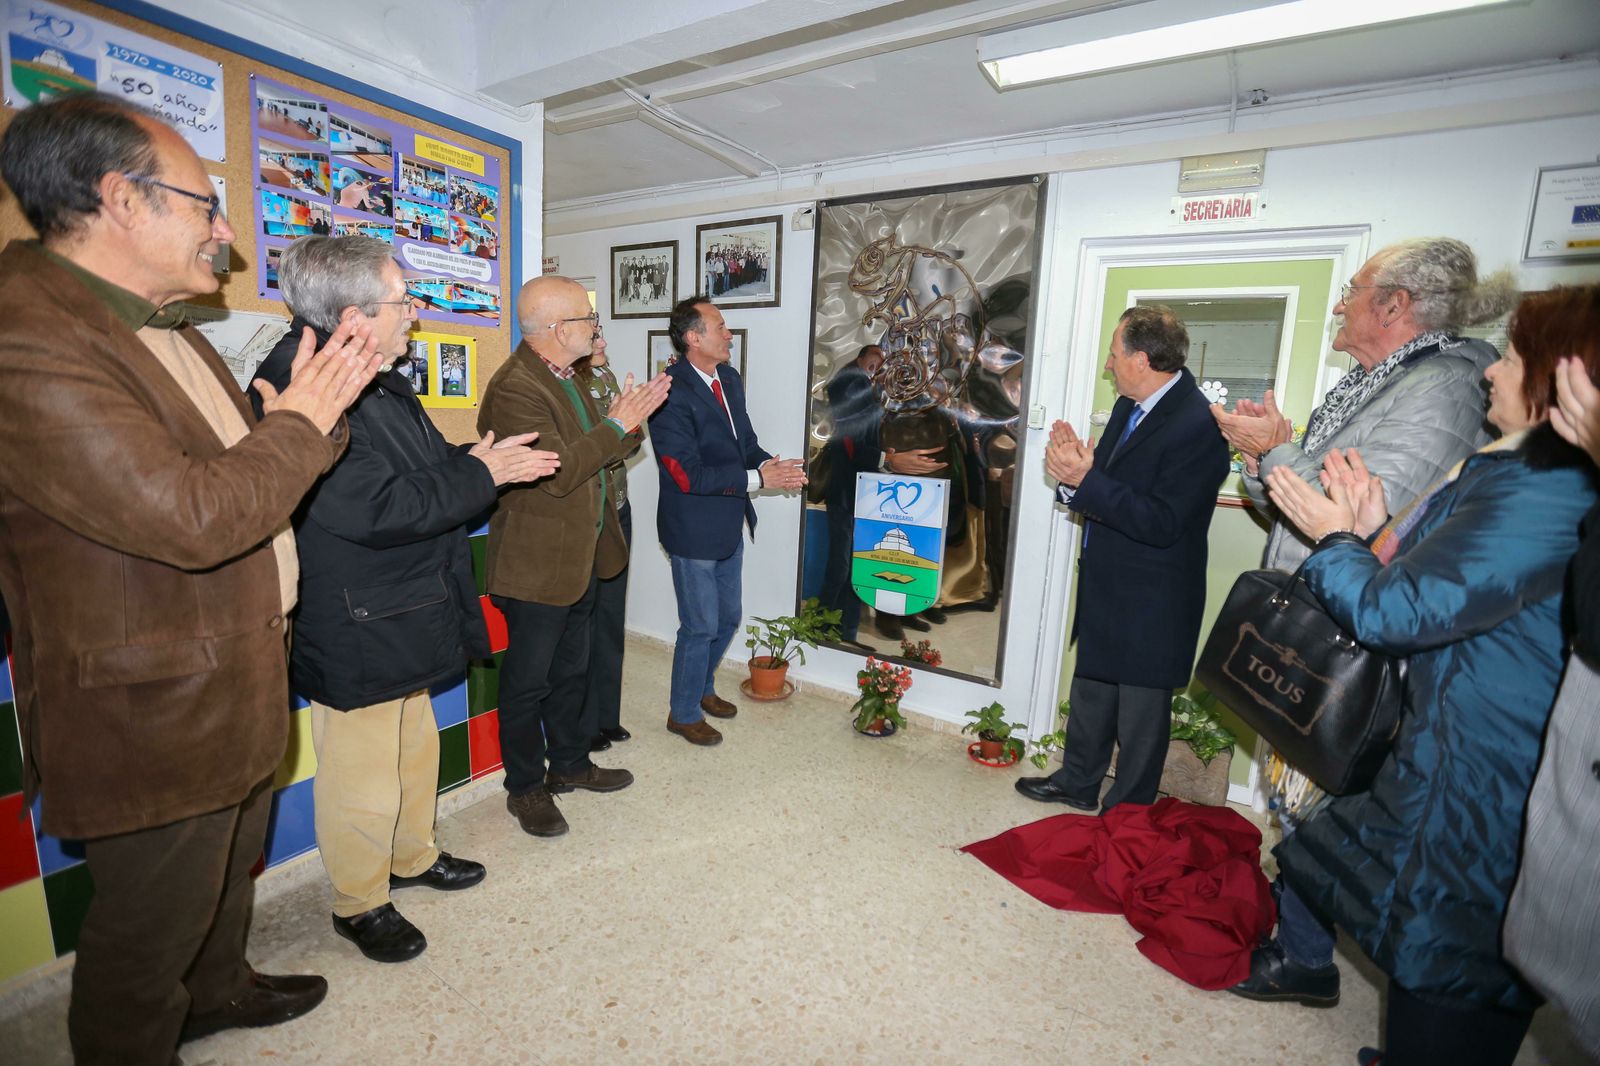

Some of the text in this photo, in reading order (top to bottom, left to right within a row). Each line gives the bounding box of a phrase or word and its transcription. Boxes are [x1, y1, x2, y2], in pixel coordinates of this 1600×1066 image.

[112, 46, 150, 66] 1970
[172, 66, 208, 86] 2020
[163, 93, 206, 117] años
[1248, 655, 1305, 704] TOUS
